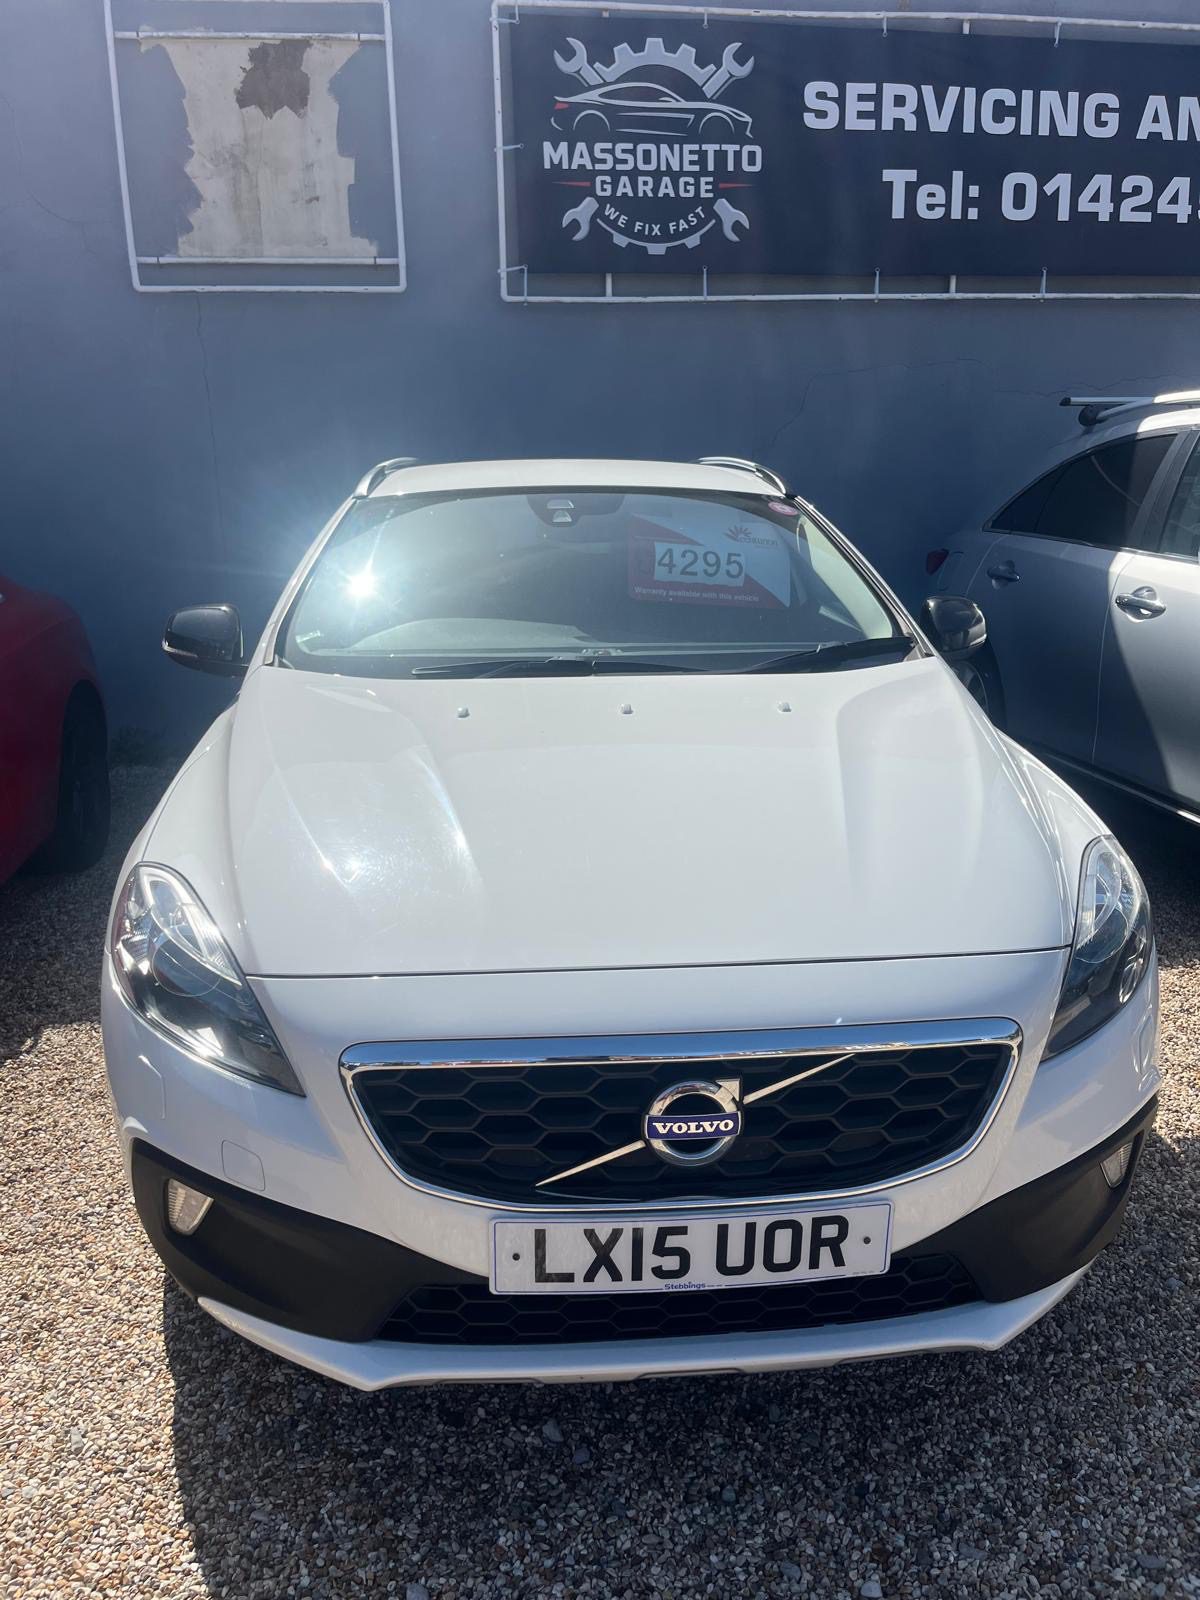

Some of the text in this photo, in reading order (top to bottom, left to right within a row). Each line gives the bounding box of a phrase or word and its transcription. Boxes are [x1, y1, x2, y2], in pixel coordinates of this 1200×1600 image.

[803, 81, 1200, 141] SERVICING AN
[543, 141, 762, 173] MASSONETTO
[595, 175, 714, 198] GARAGE
[882, 169, 1200, 223] Tel: 01424
[604, 204, 706, 236] WE FIX FAST
[657, 548, 744, 579] 4295
[634, 586, 667, 596] Warranty
[669, 590, 700, 598] available
[702, 591, 718, 600] with
[719, 593, 732, 601] this
[653, 1119, 735, 1134] VOLVO
[534, 1215, 849, 1283] LX15 UOR
[664, 1282, 707, 1290] Stebbings
